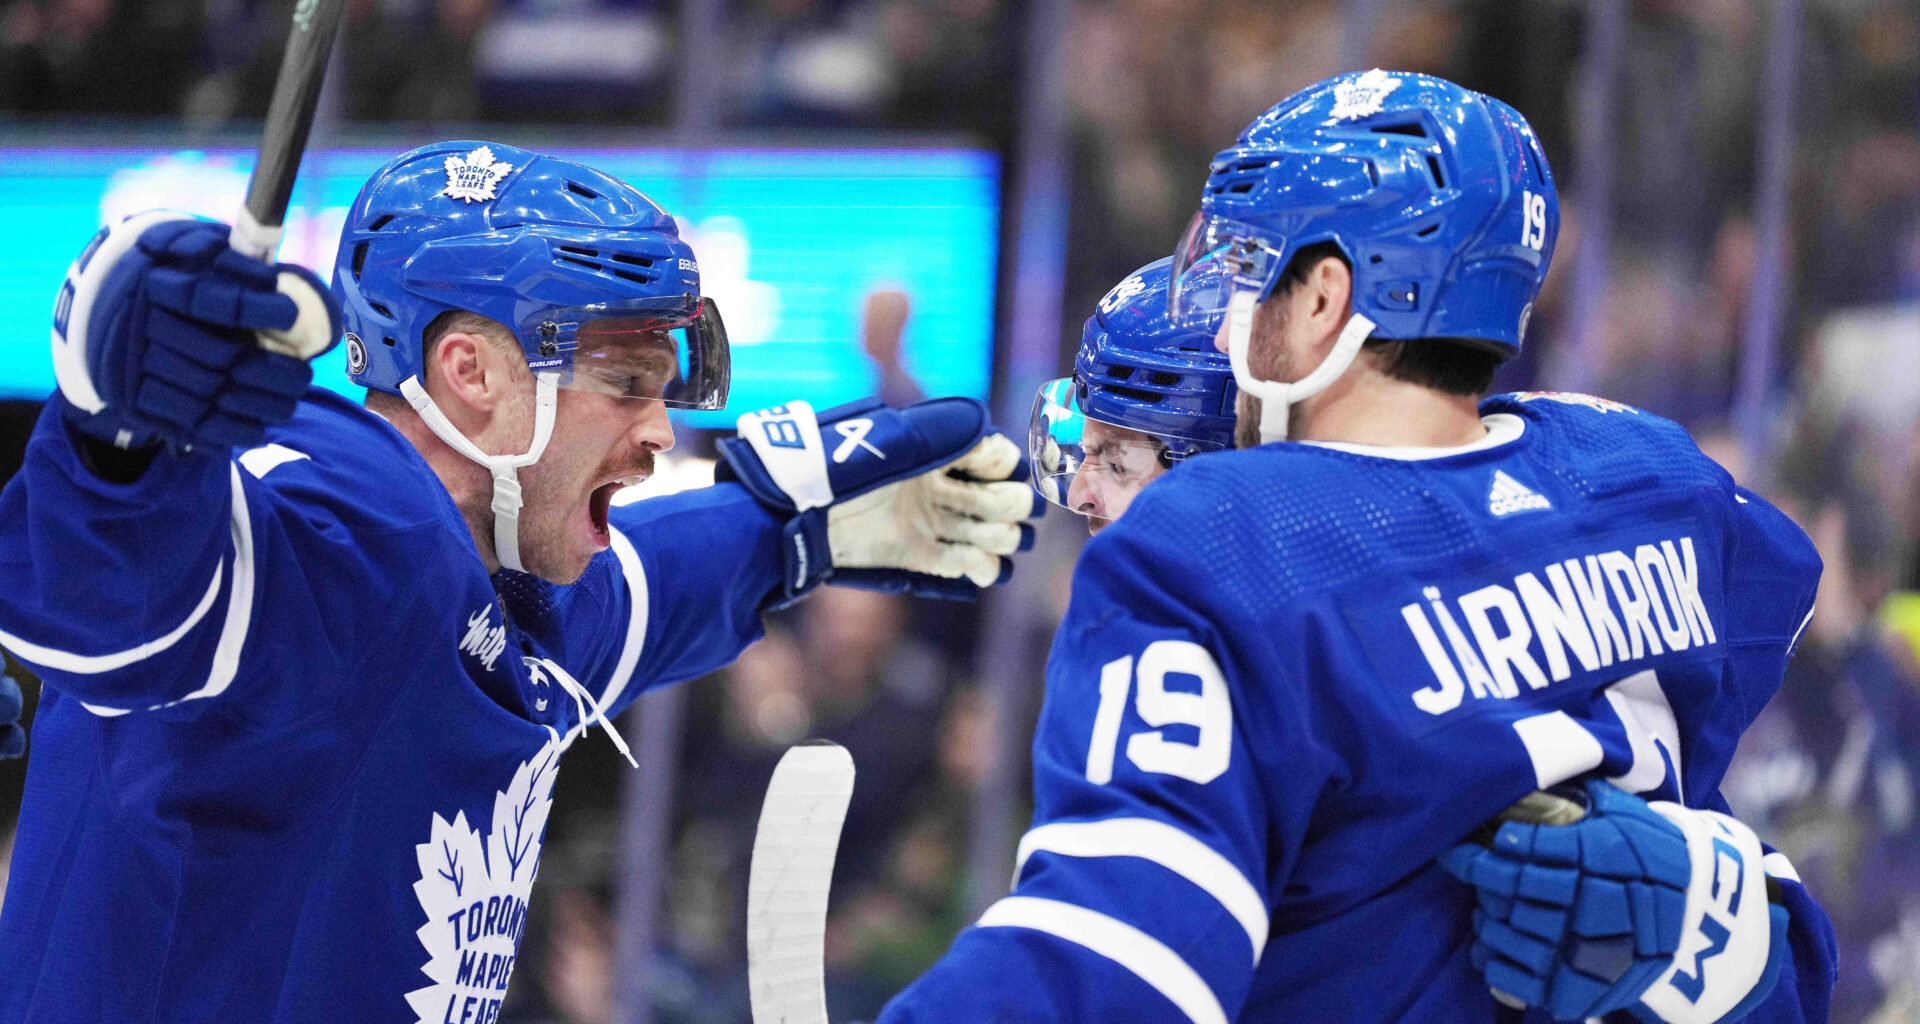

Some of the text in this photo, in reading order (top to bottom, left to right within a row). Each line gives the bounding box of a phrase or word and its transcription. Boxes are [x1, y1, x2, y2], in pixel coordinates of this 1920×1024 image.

[453, 165, 496, 179] TORONTO
[456, 181, 485, 190] LEAFS
[458, 173, 487, 183] MAPLE
[1521, 190, 1546, 251] 19
[529, 359, 563, 368] BAUER
[1400, 536, 1717, 716] JÄRNKROK
[1085, 639, 1234, 786] 19
[1668, 821, 1745, 1006] CM
